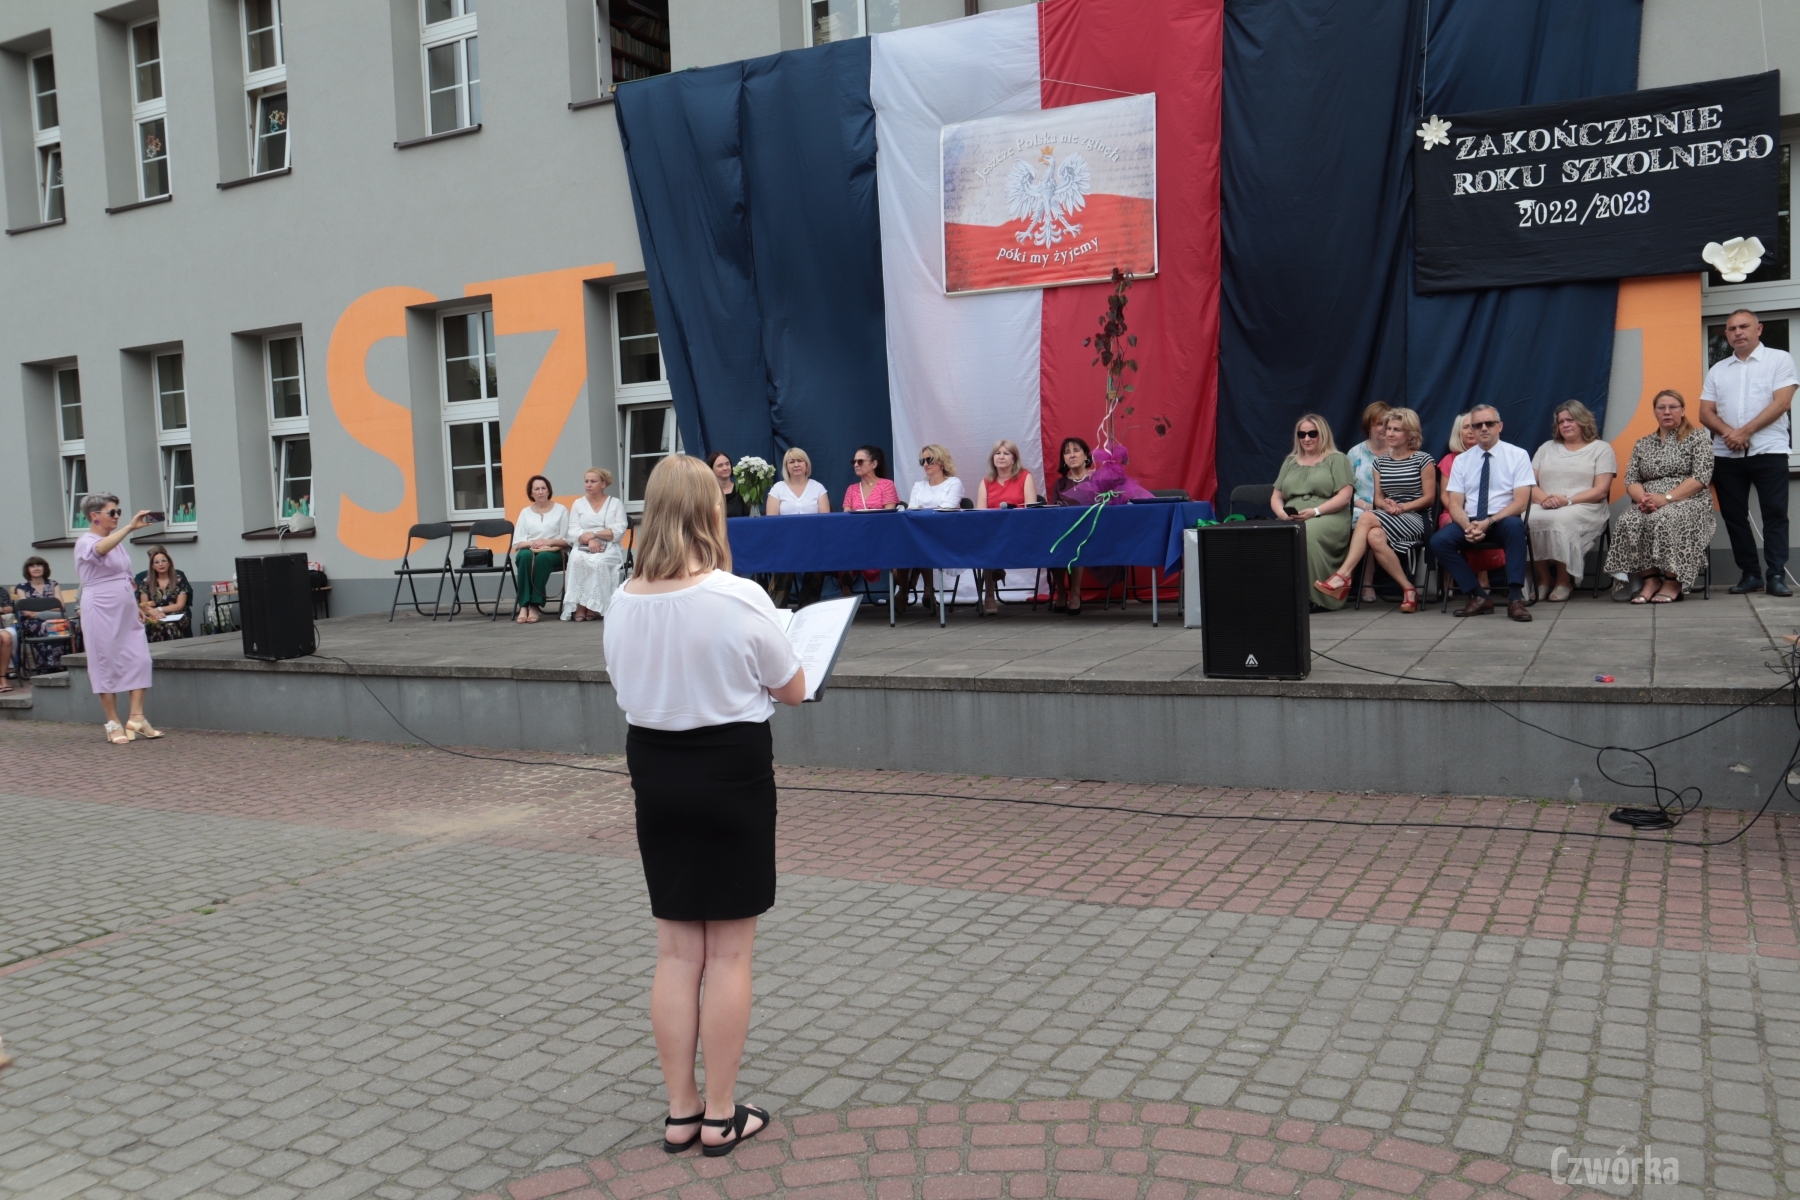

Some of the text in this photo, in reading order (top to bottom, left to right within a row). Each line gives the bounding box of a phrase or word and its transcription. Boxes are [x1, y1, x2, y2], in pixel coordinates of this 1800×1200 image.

[975, 131, 1121, 182] Jeszcze Polska nie zginęła
[1455, 104, 1723, 160] ZAKOŃCZENIE
[1453, 134, 1774, 196] ROKU SZKOLNEGO
[1515, 189, 1651, 228] 2022/2023
[996, 236, 1100, 268] póki my żyjemy
